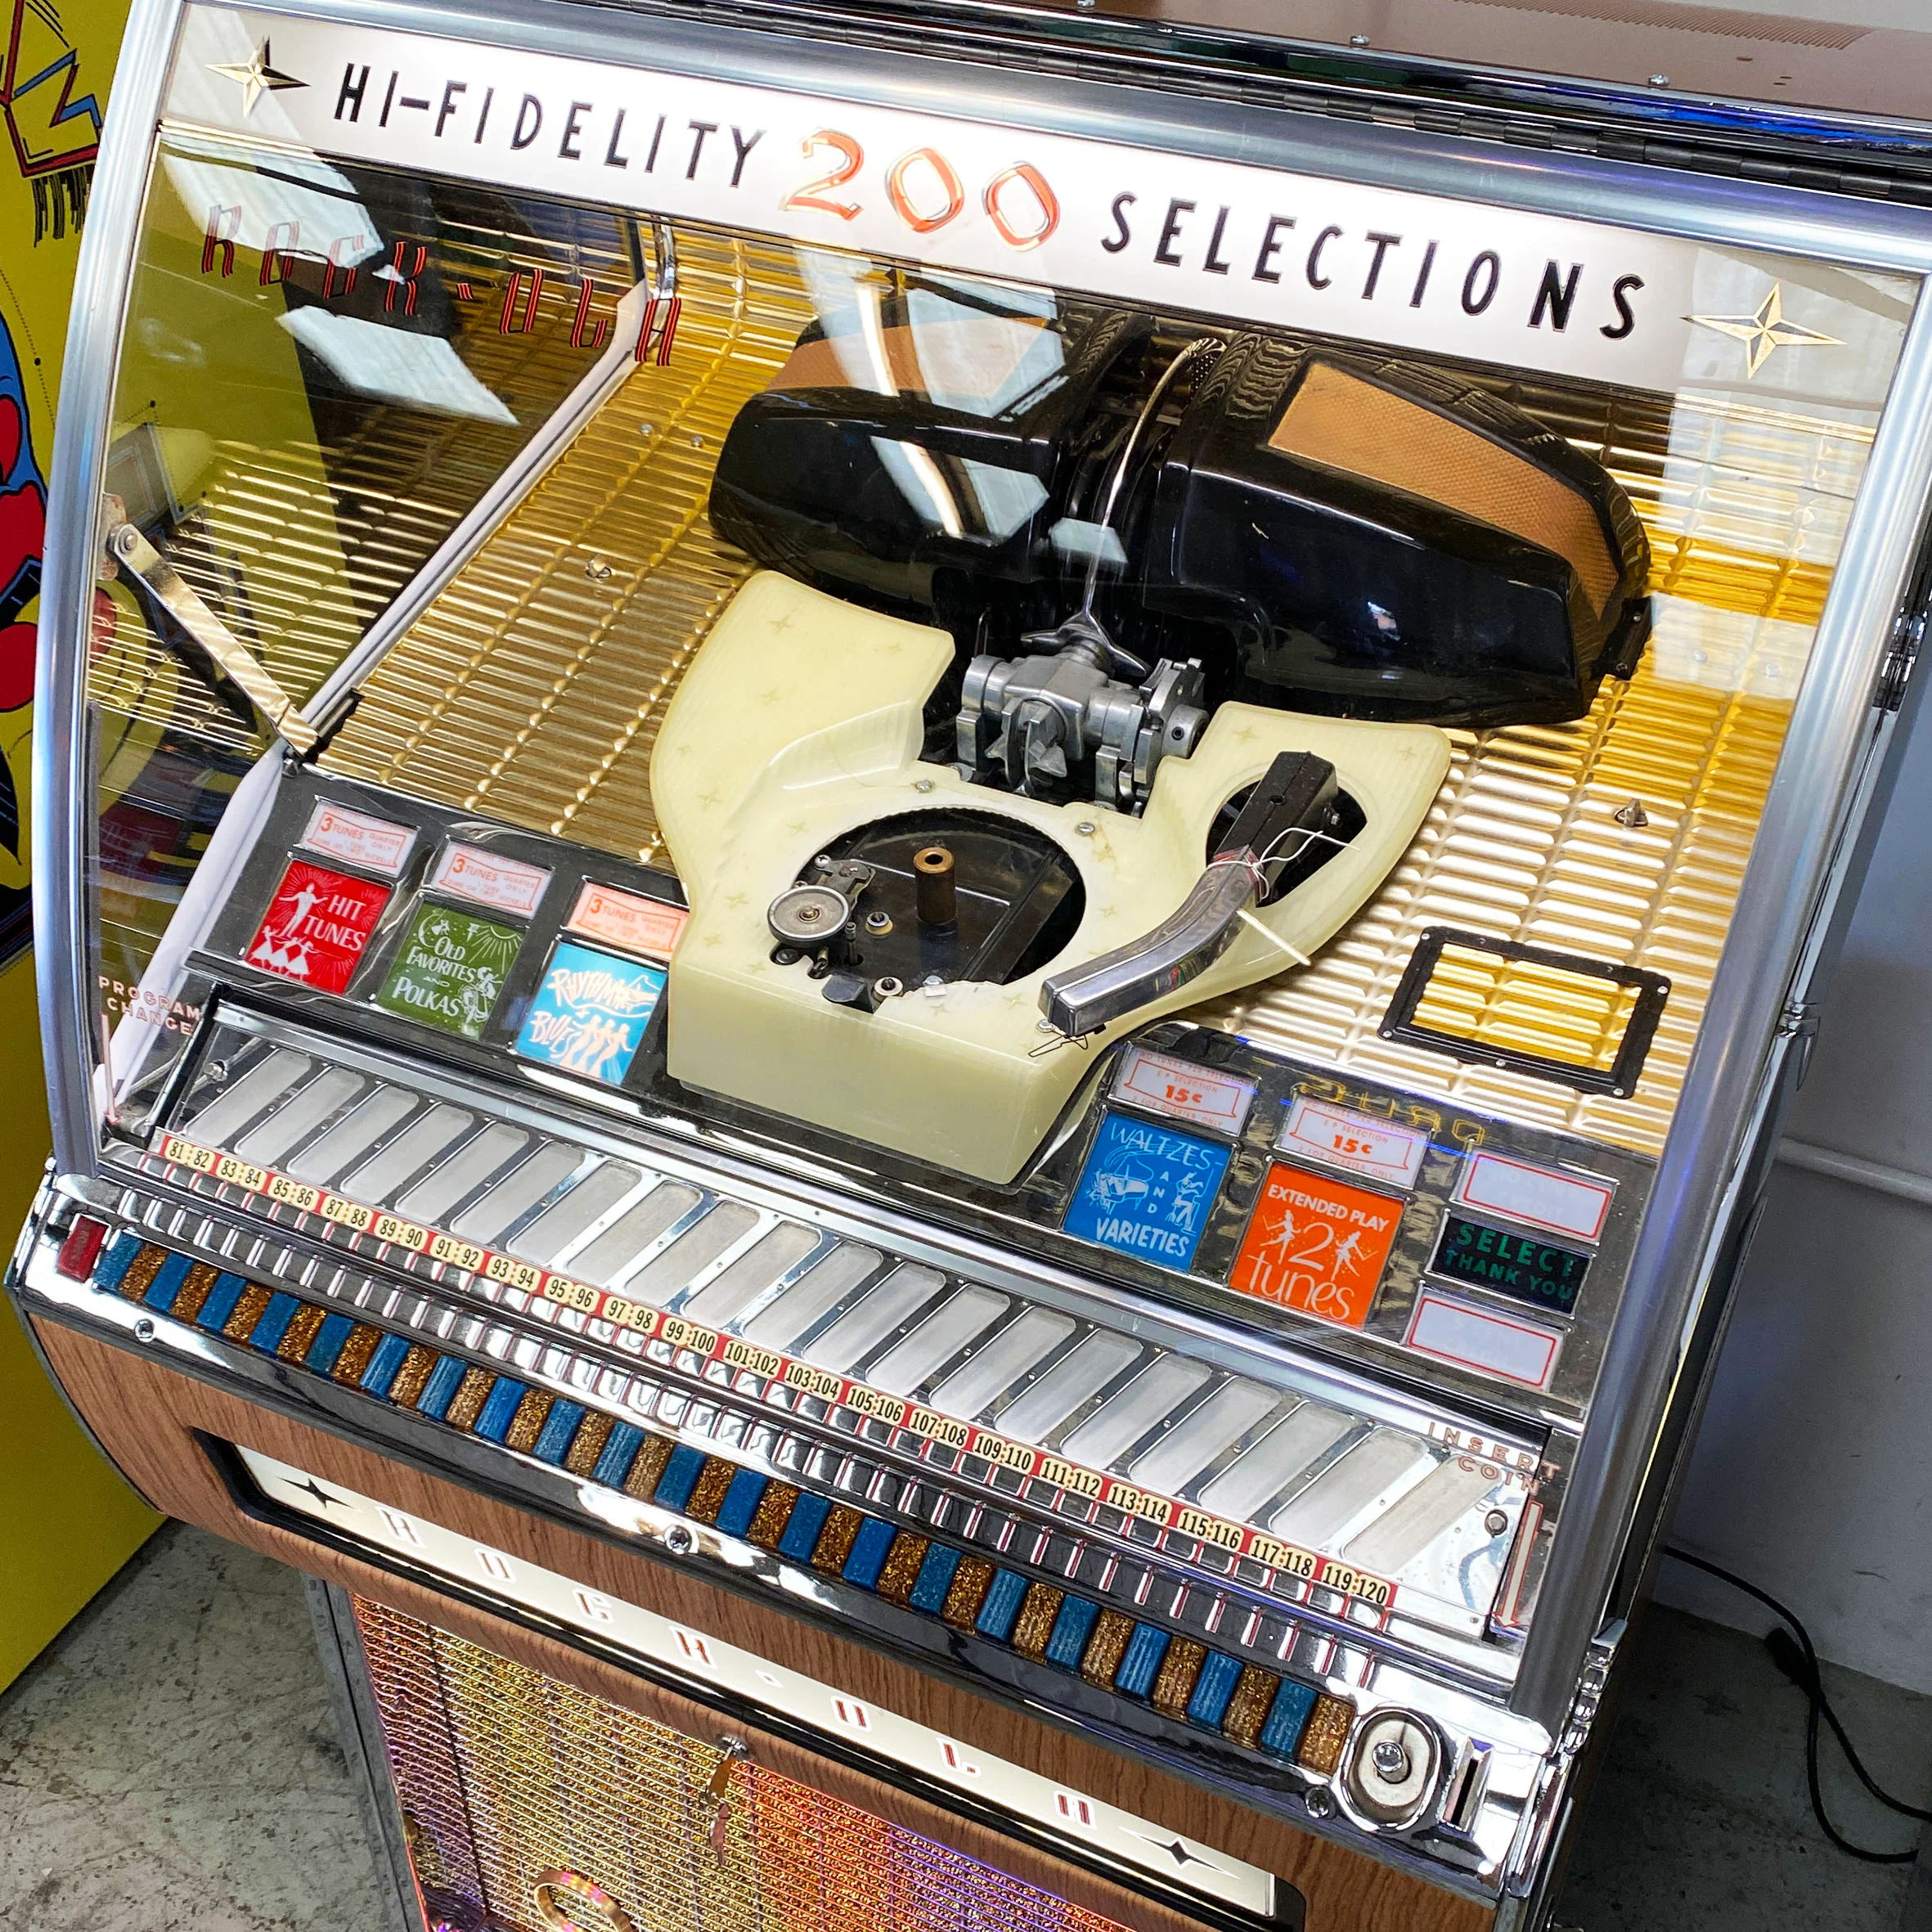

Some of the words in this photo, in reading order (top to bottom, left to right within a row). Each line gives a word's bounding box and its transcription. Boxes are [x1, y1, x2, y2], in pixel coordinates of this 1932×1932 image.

[334, 62, 768, 188] HI-FIDELITY
[780, 126, 1063, 252] 200
[1100, 191, 1645, 339] SELECTIONS
[321, 817, 333, 832] 3
[333, 823, 365, 840] TUNES
[453, 858, 465, 873] 3
[465, 865, 498, 882] TUNES
[326, 894, 366, 922] HIT
[591, 898, 603, 914] 3
[602, 905, 636, 923] TUNES
[303, 914, 366, 951] TUNES
[406, 946, 478, 983] FAVORITES
[97, 976, 203, 1021] PROGRAM
[392, 976, 462, 1017] POLKAS
[1174, 1075, 1219, 1093] SELECTION
[1160, 1104, 1197, 1120] QUARTER
[1111, 1122, 1215, 1170] WALTZES
[1341, 1124, 1389, 1143] SELECTION
[1328, 1154, 1366, 1170] QUARTER
[1268, 1184, 1348, 1220] EXTENDED
[1349, 1210, 1390, 1232] PLAY
[1096, 1217, 1190, 1257] VARIETIES
[1288, 1222, 1334, 1272] 2
[1456, 1223, 1579, 1278] SELECT
[1247, 1250, 1355, 1320] tunes
[1445, 1249, 1521, 1285] THANK
[1530, 1275, 1573, 1301] YOU
[1427, 1422, 1561, 1480] INSERT
[1458, 1456, 1540, 1496] COIN
